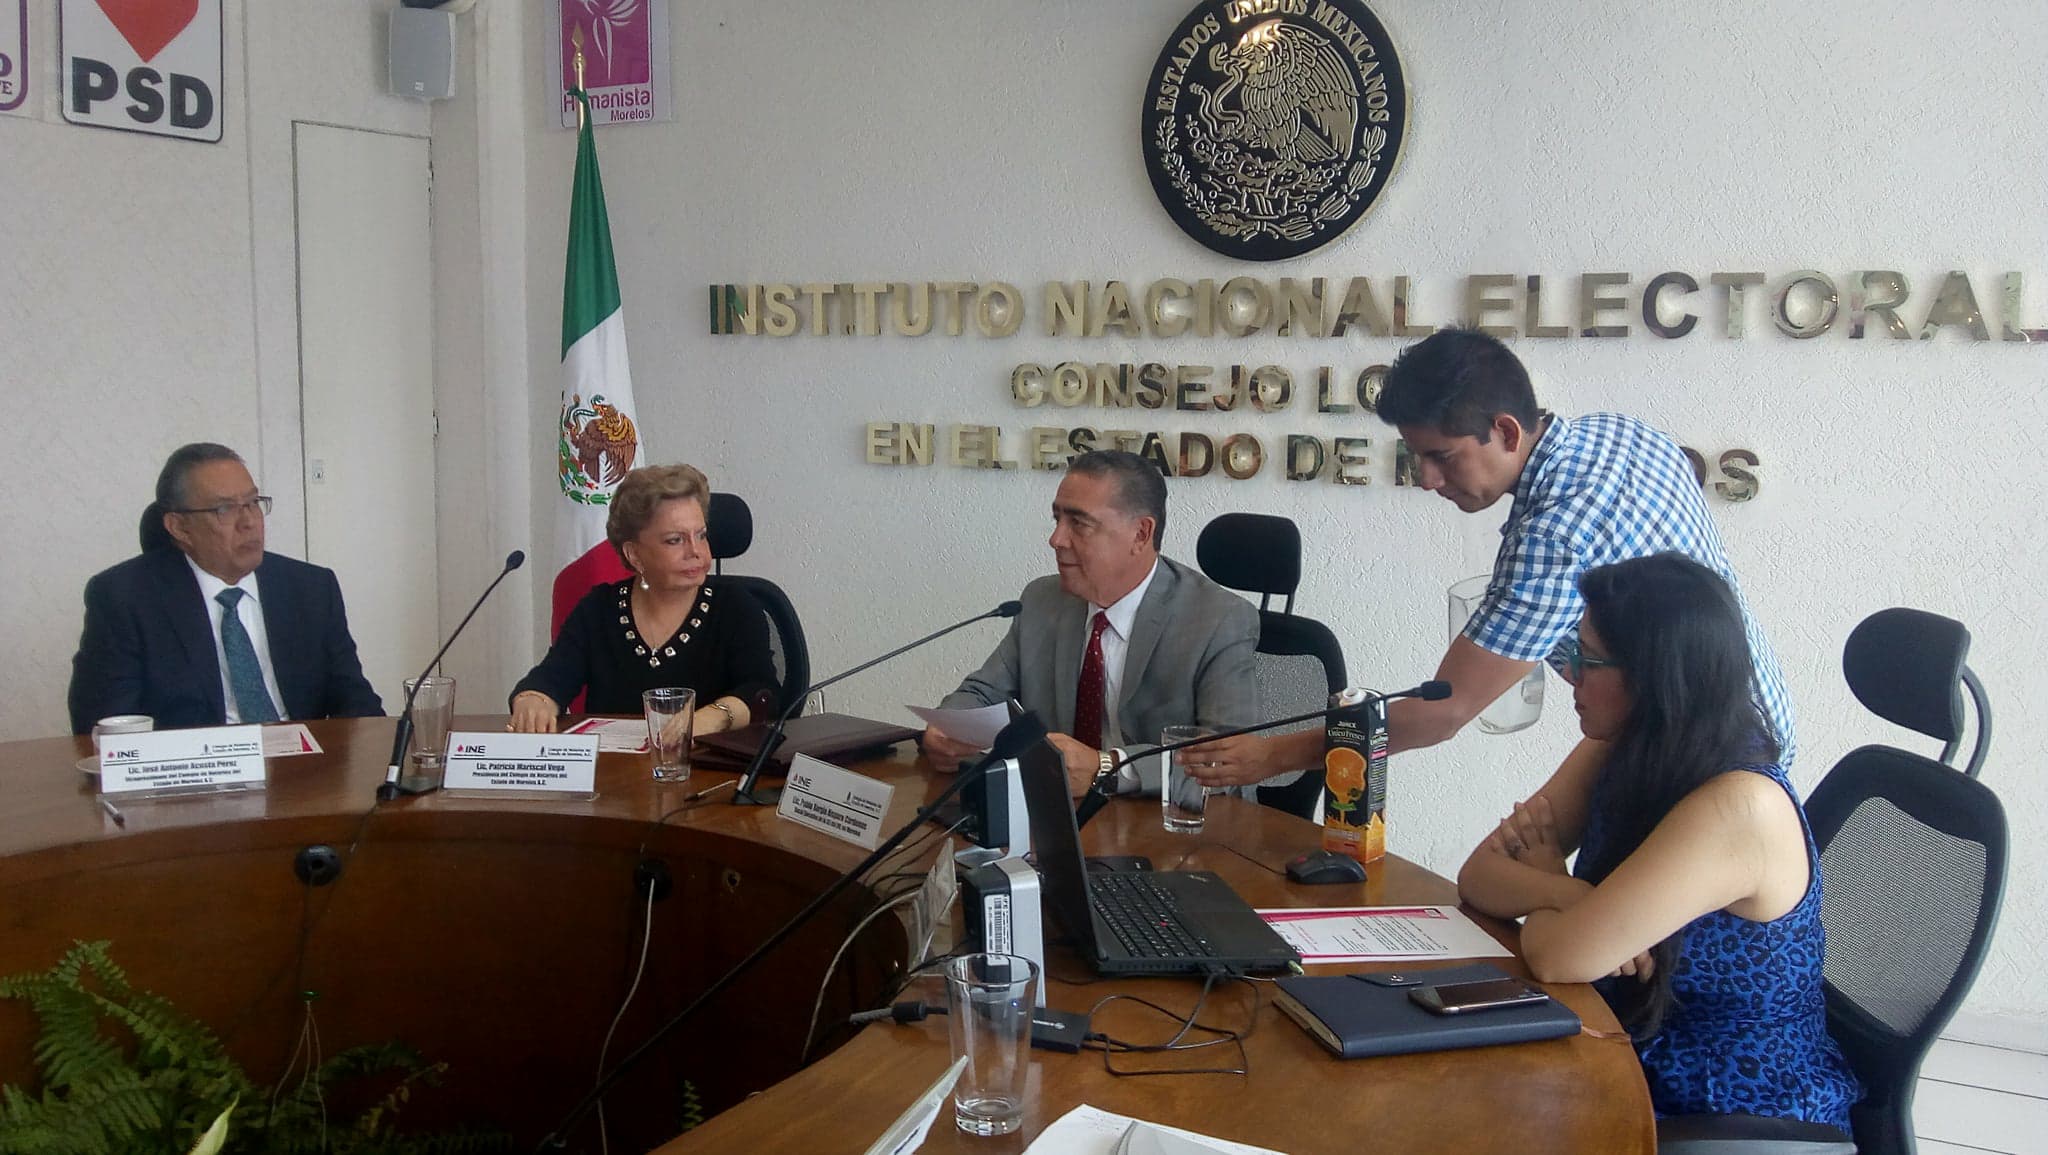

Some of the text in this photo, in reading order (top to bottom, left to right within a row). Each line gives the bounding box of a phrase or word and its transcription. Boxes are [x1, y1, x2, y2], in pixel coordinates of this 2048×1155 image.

[1156, 0, 1390, 122] ESTADOS UNIDOS MEXICANOS
[72, 56, 213, 130] PSD
[564, 88, 650, 112] Hmanista
[611, 109, 650, 121] Morelos
[708, 270, 2048, 343] INSTITUTO NACIONAL ELECTORAL
[1010, 361, 1297, 413] CONSEJO
[866, 422, 935, 466] EN
[951, 423, 1018, 470] EL
[1286, 432, 1373, 486] DE
[117, 749, 139, 759] INE
[465, 745, 486, 753] INE
